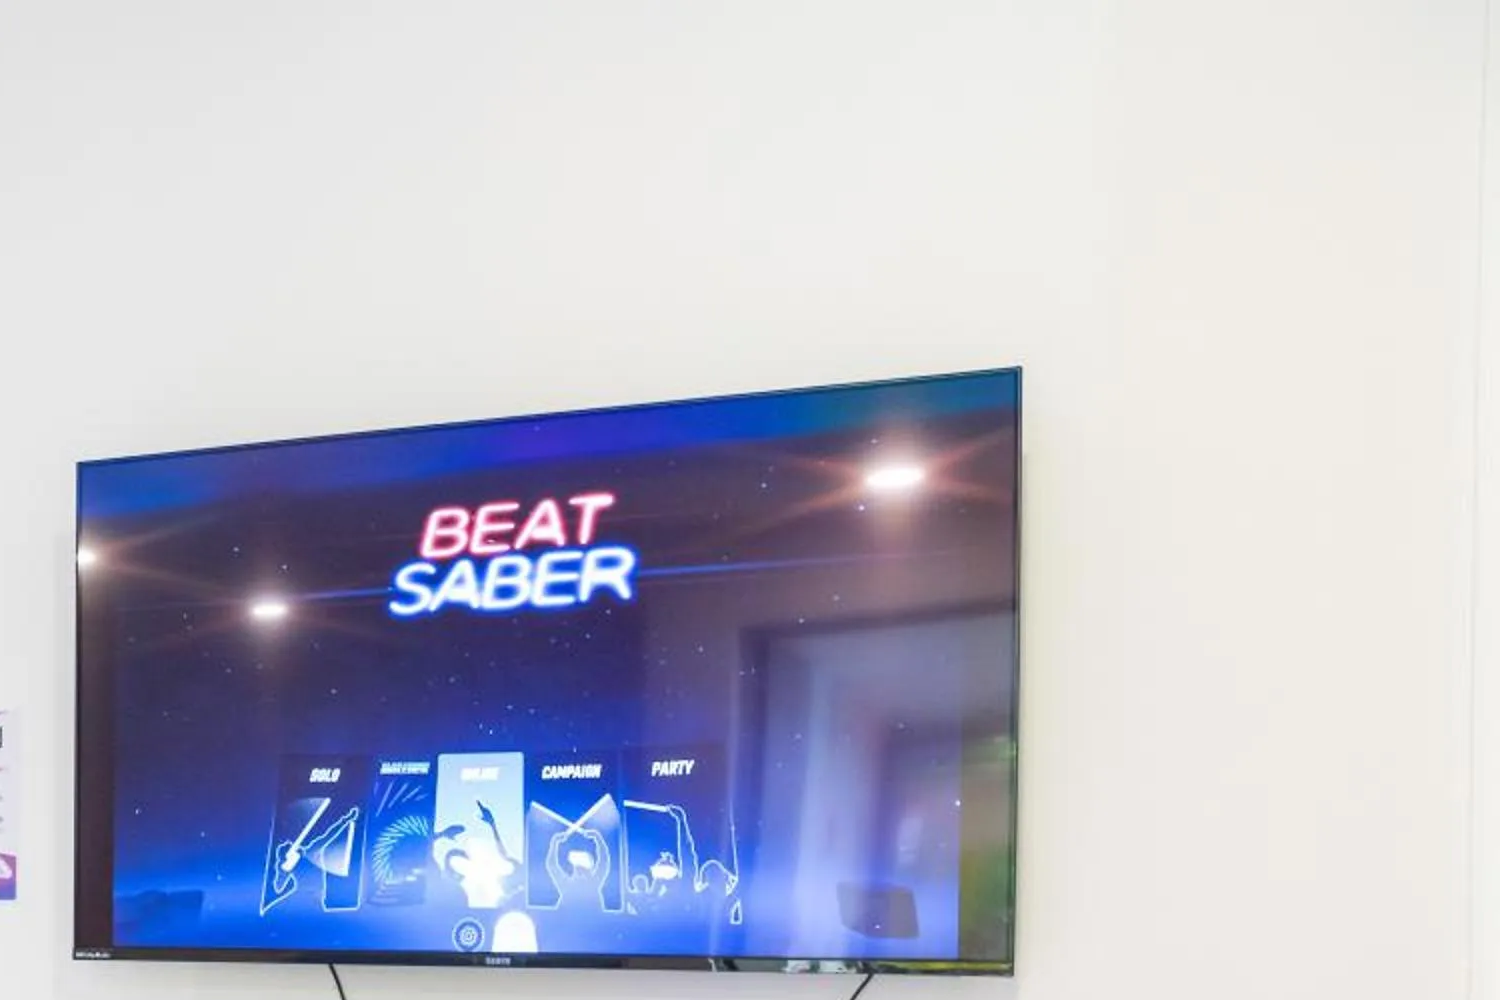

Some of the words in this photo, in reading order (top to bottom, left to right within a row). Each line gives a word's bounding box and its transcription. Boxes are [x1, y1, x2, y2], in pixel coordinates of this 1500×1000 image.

[420, 493, 615, 558] BEAT
[389, 546, 636, 615] SABER
[309, 767, 341, 783] SOLO
[541, 764, 602, 780] CAMPAIGN
[651, 760, 695, 777] PARTY
